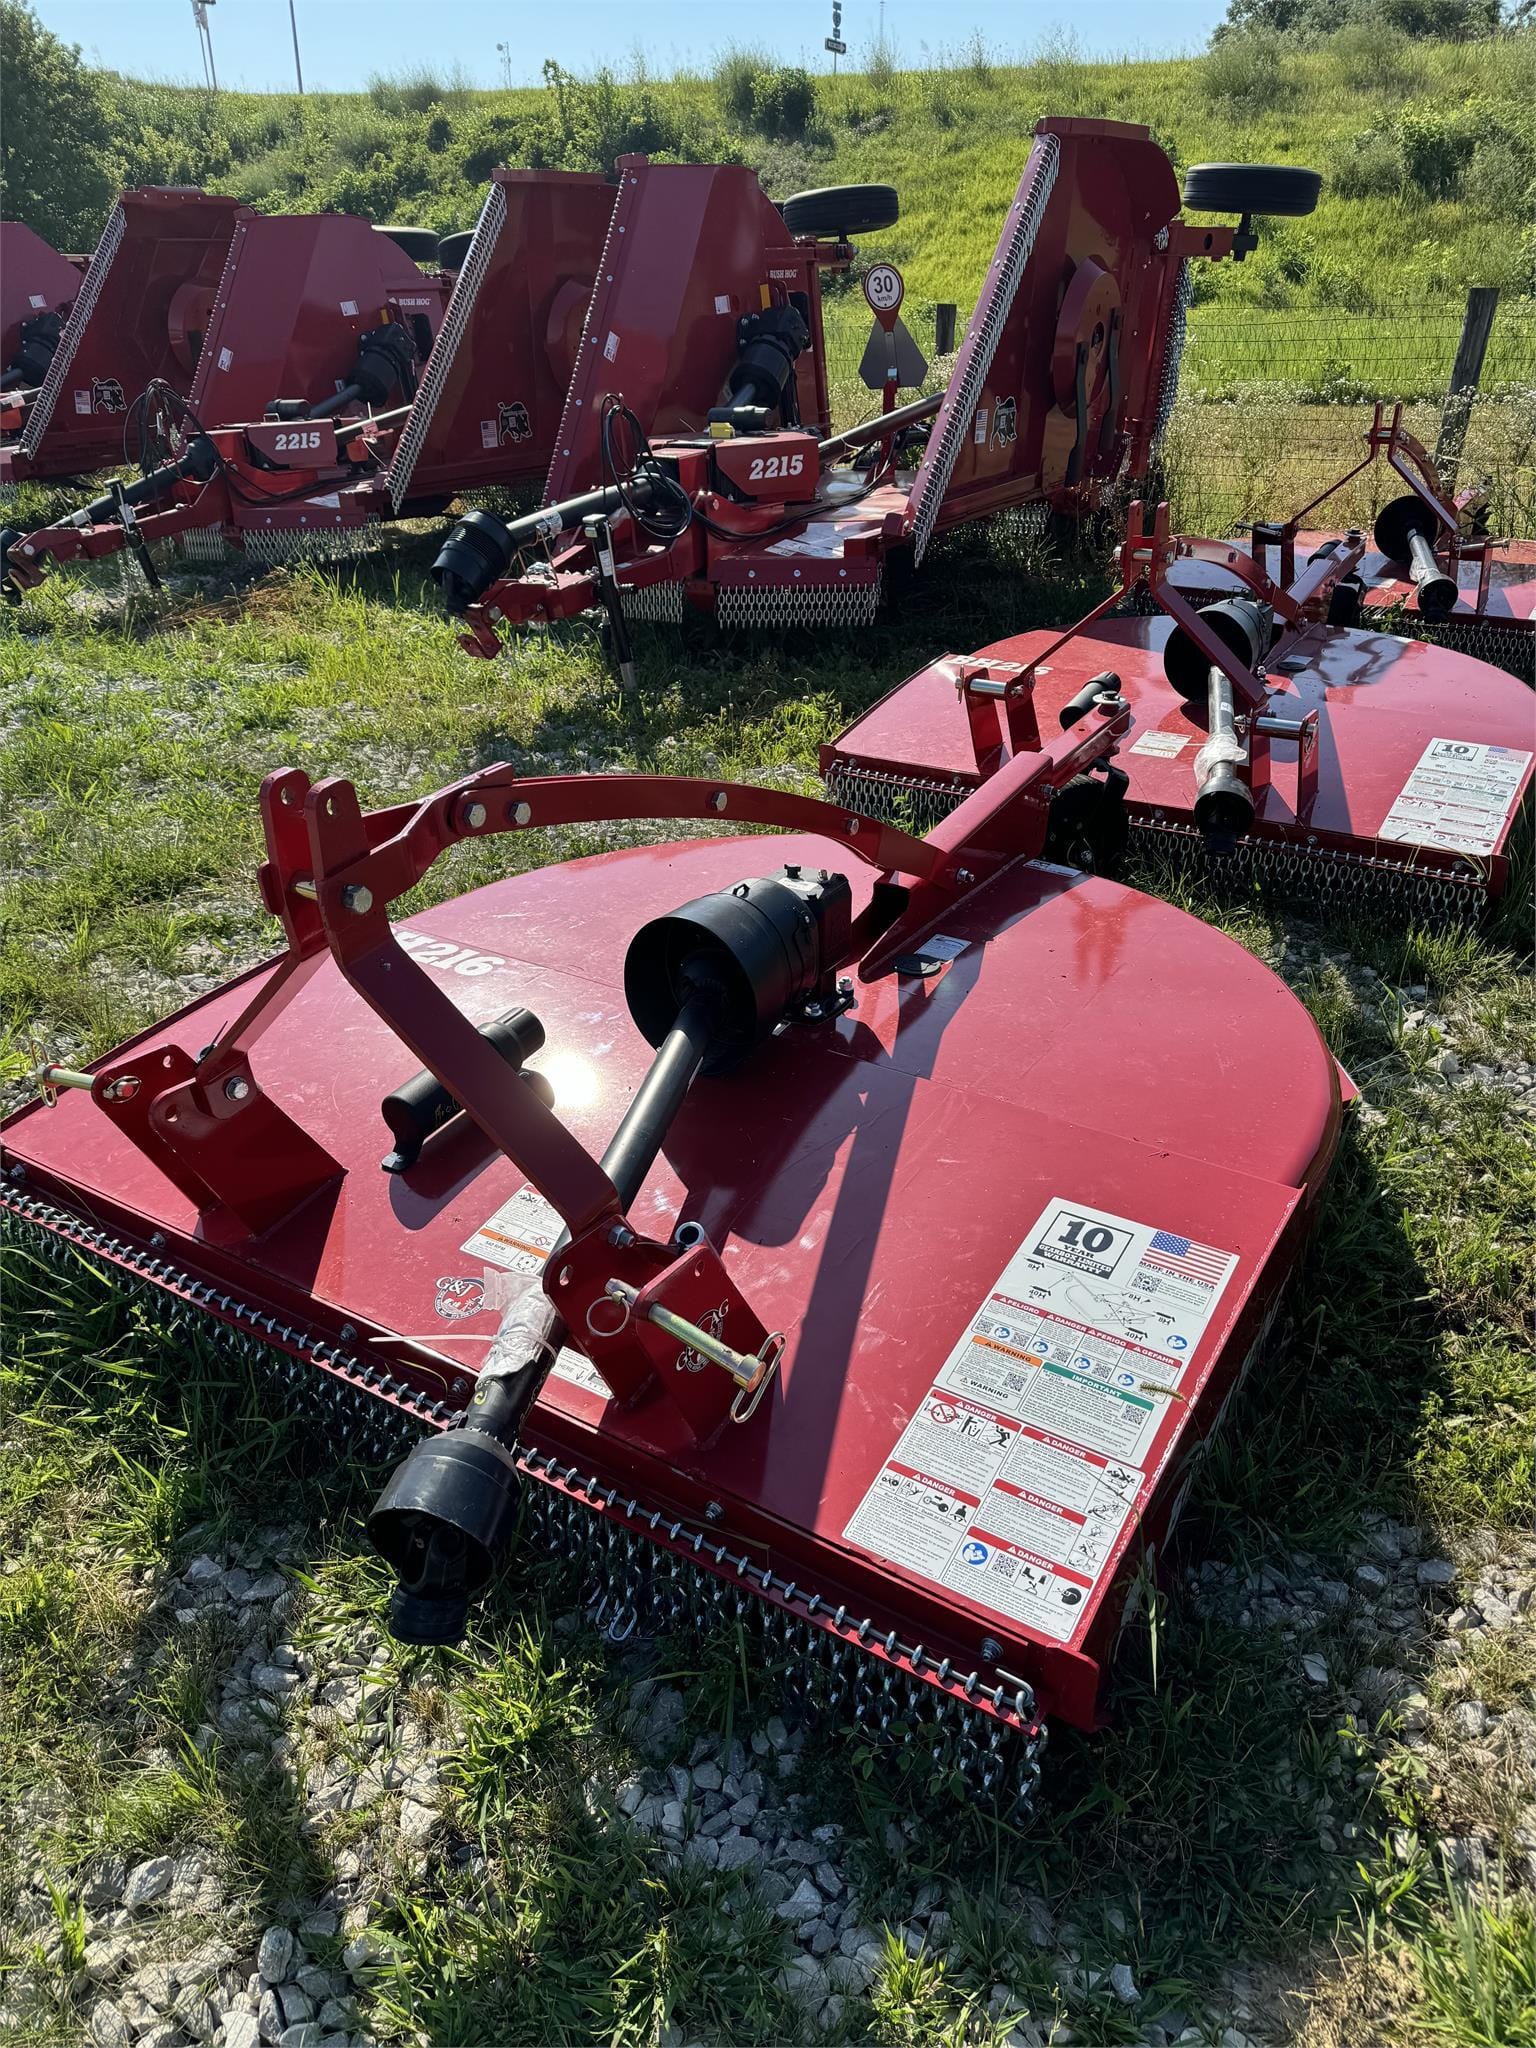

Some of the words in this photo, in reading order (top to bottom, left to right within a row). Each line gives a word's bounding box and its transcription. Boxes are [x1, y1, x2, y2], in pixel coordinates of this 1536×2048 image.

[769, 270, 784, 278] BUSH
[785, 269, 797, 278] HOG
[873, 275, 893, 294] 30
[399, 298, 415, 306] BUSH
[416, 298, 430, 306] HOG
[877, 294, 893, 302] km/h
[275, 432, 320, 450] 2215
[749, 454, 804, 480] 2215
[1442, 744, 1470, 754] 10
[503, 1237, 531, 1251] WARNING
[1058, 1220, 1114, 1253] 10
[1039, 1244, 1077, 1261] GEARBOX
[1078, 1257, 1112, 1272] LIMITED
[1064, 1245, 1094, 1258] YEAR
[1043, 1251, 1102, 1274] WARRANTY
[1139, 1261, 1162, 1272] MADE
[1165, 1269, 1175, 1277] IN
[1178, 1274, 1195, 1284] THE
[1197, 1280, 1215, 1290] USA
[436, 1276, 474, 1297] G&J
[1129, 1293, 1141, 1302] 8H
[1007, 1300, 1040, 1314] PELIGRO
[1055, 1317, 1087, 1332] DANGER
[1096, 1331, 1127, 1347] PERIGO
[1124, 1331, 1143, 1341] 40H
[994, 1344, 1031, 1362] WARNING
[1142, 1349, 1174, 1365] GEFAHR
[559, 1363, 575, 1373] HERE
[970, 1380, 1009, 1399] WARNING
[1072, 1375, 1122, 1397] IMPORTANT
[964, 1404, 997, 1421] DANGER
[1051, 1440, 1086, 1459] DANGER
[922, 1477, 956, 1496] DANGER
[1027, 1494, 1064, 1514] DANGER
[1017, 1550, 1054, 1571] DANGER
